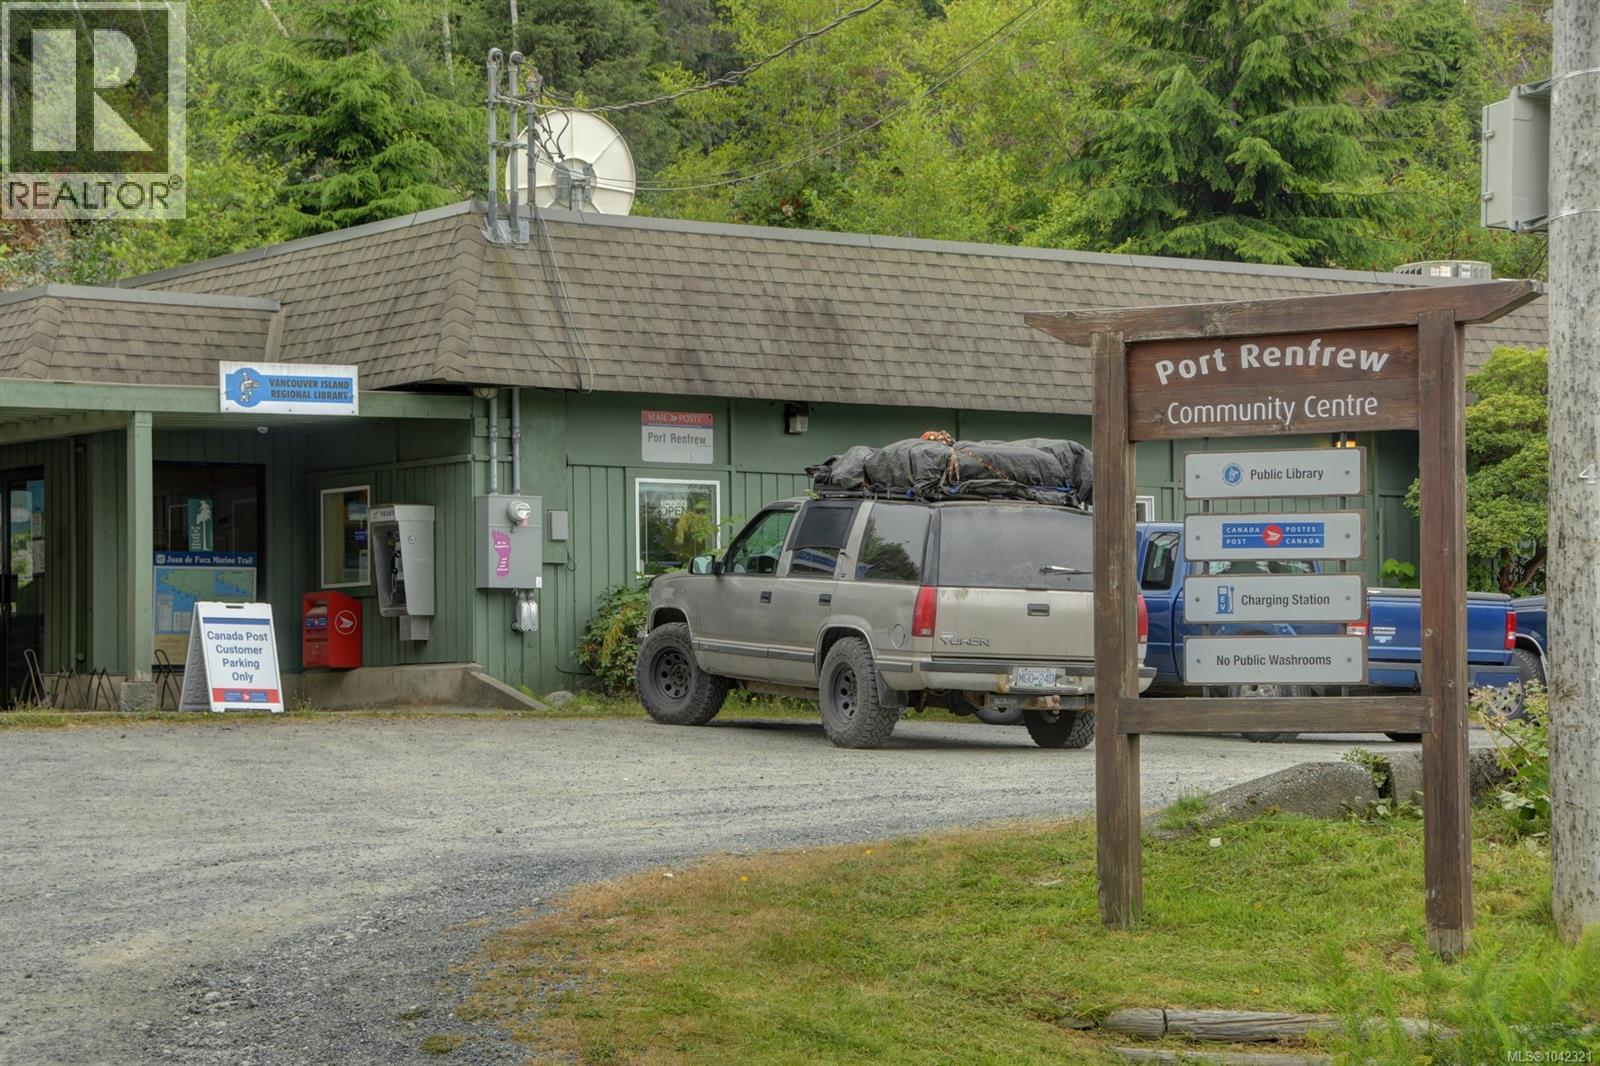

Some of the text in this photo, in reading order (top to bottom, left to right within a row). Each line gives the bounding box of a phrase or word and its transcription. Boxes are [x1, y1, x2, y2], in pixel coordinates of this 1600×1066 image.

[1154, 338, 1390, 385] Port Renfrew
[269, 378, 350, 390] VANCOUVER ISLAND
[271, 389, 349, 400] REGIONAL LIBRARY
[1167, 394, 1378, 426] Community Centre
[647, 413, 702, 424] MAIL POSTE
[647, 431, 707, 445] Port Renfrew
[1250, 468, 1324, 481] Public Library
[660, 505, 688, 517] OPEN
[167, 555, 253, 565] Juan de Fuca Marine Trail
[1241, 594, 1331, 608] Charging Station
[207, 630, 269, 642] Canada Post
[940, 637, 991, 647] YUKON
[215, 644, 263, 655] Customer
[222, 658, 260, 671] Parking
[1216, 654, 1332, 666] No Public Washrooms
[231, 671, 254, 683] Only
